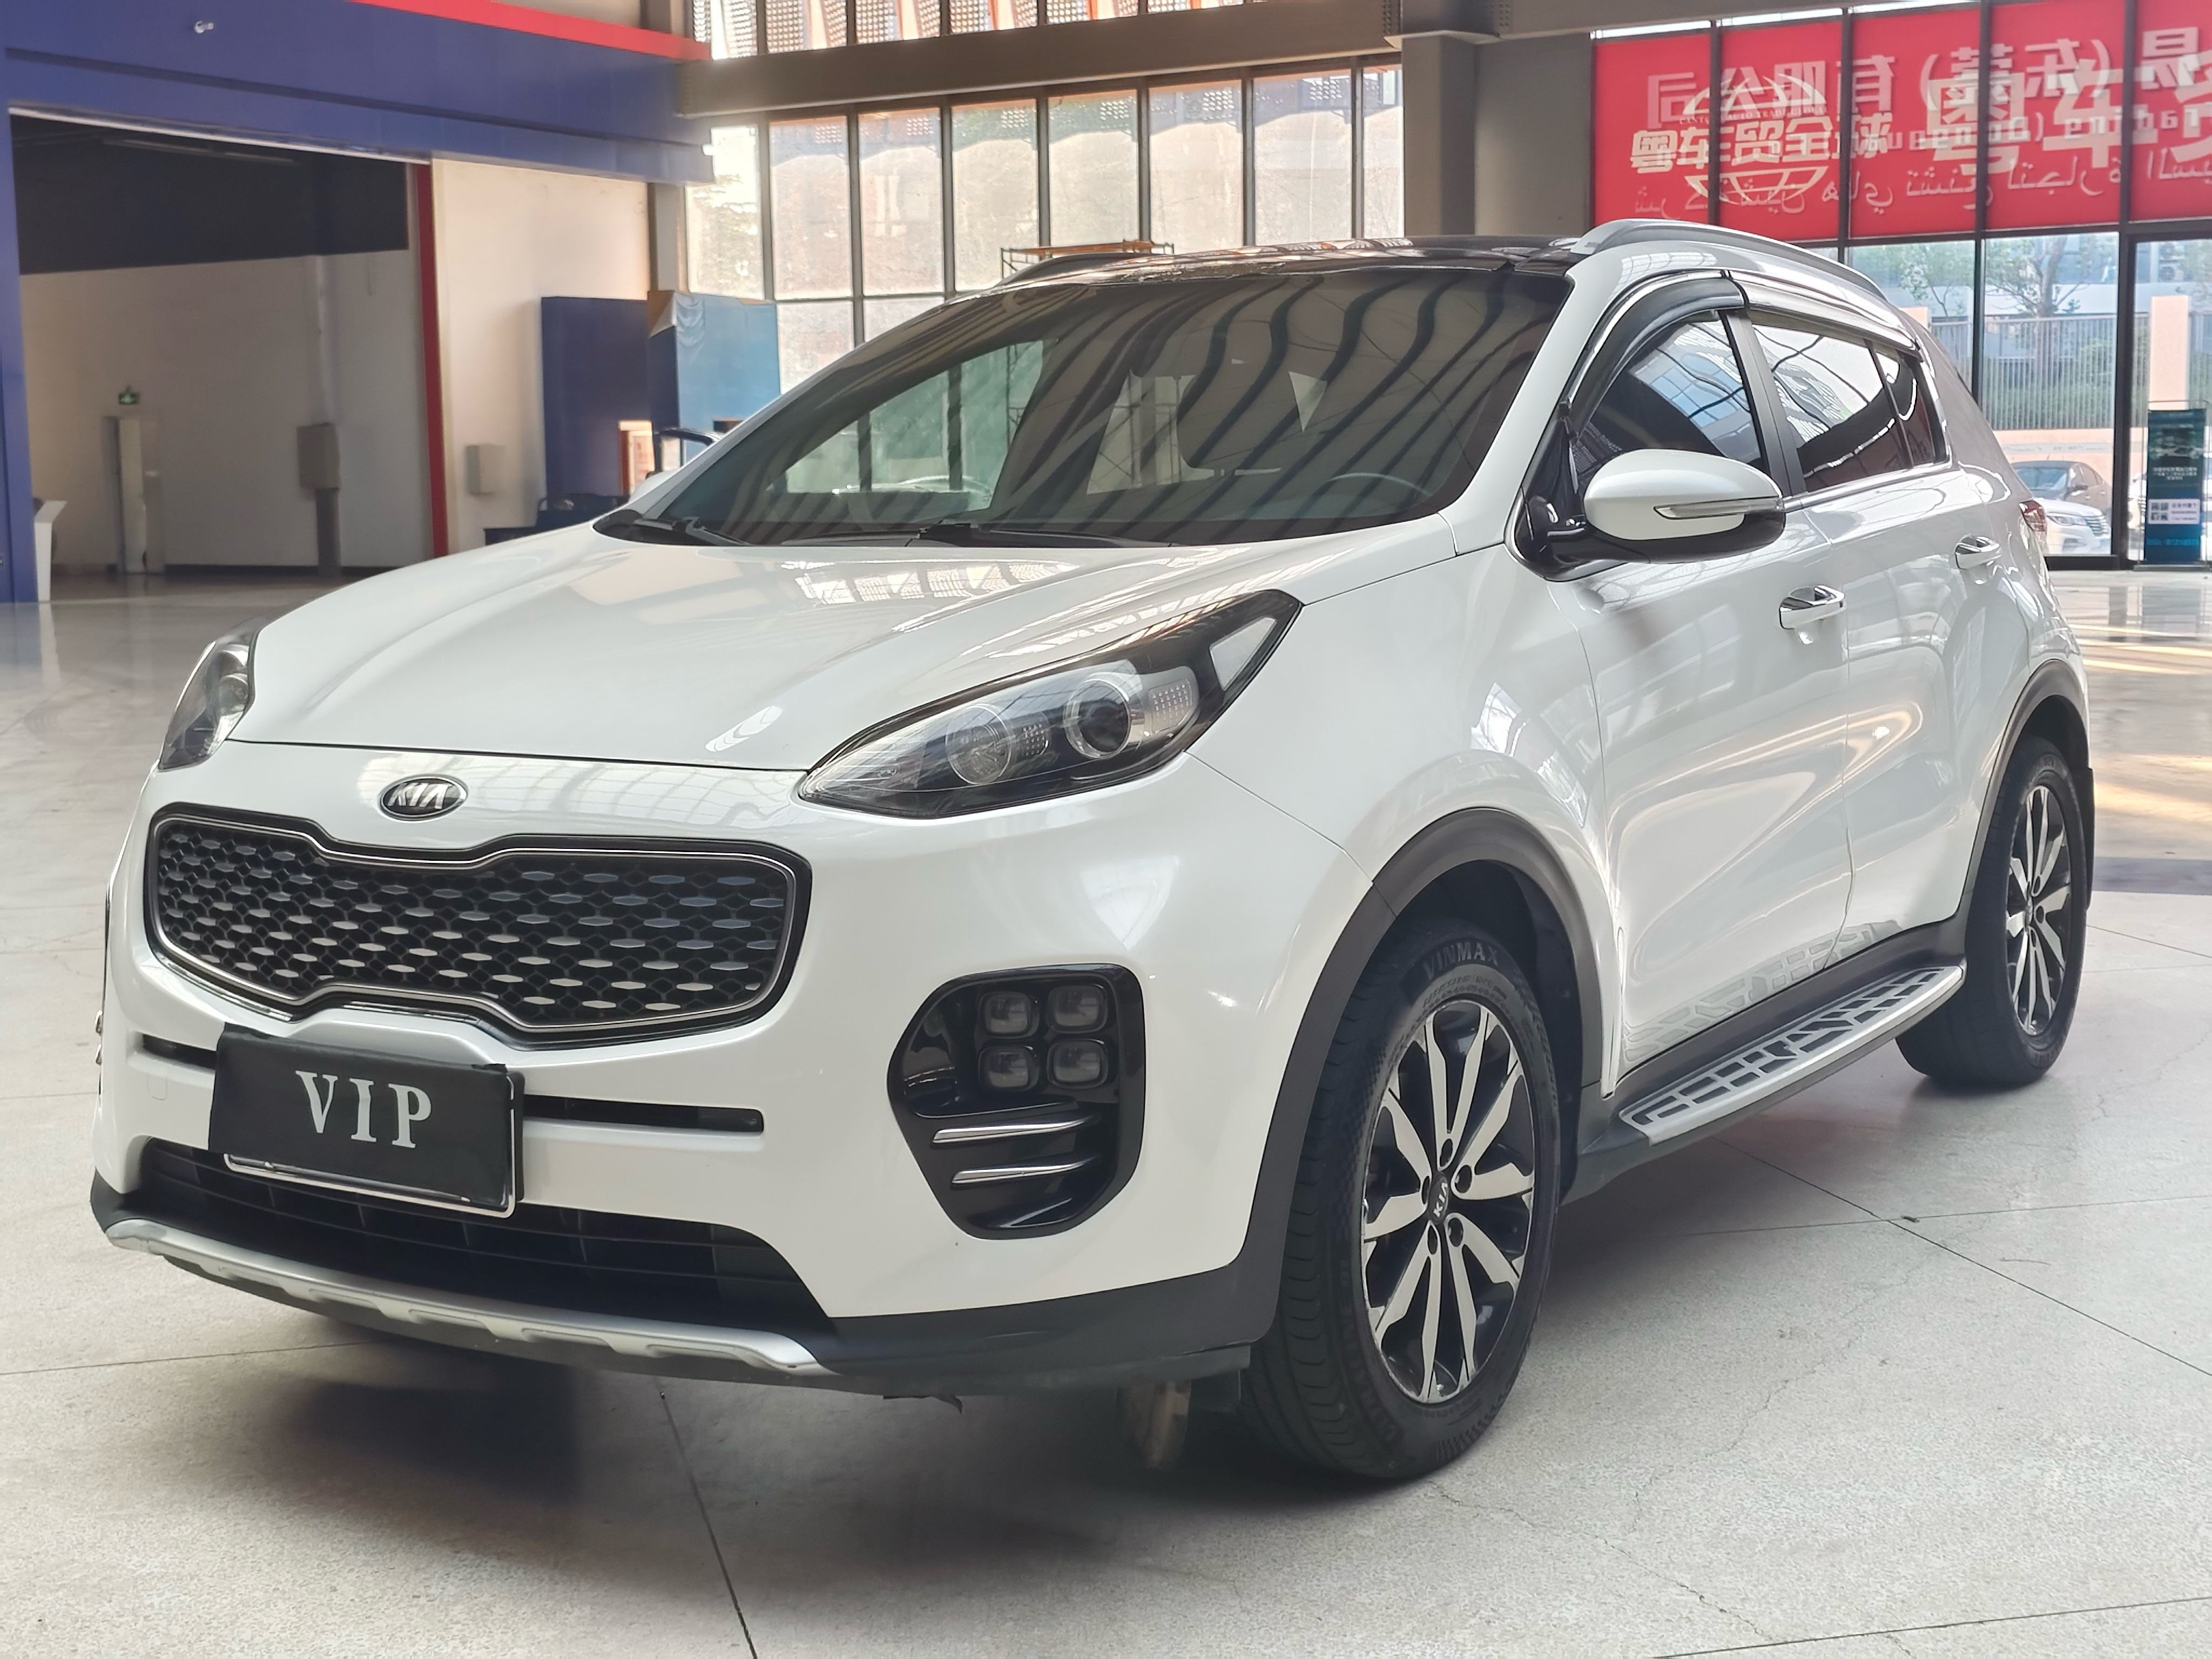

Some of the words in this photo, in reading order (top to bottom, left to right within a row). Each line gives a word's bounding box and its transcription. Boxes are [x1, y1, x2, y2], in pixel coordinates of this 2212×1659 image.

[388, 783, 453, 810] KIA
[1422, 941, 1499, 980] VINMAX
[295, 1070, 432, 1149] VIP
[1433, 1182, 1448, 1218] KIA
